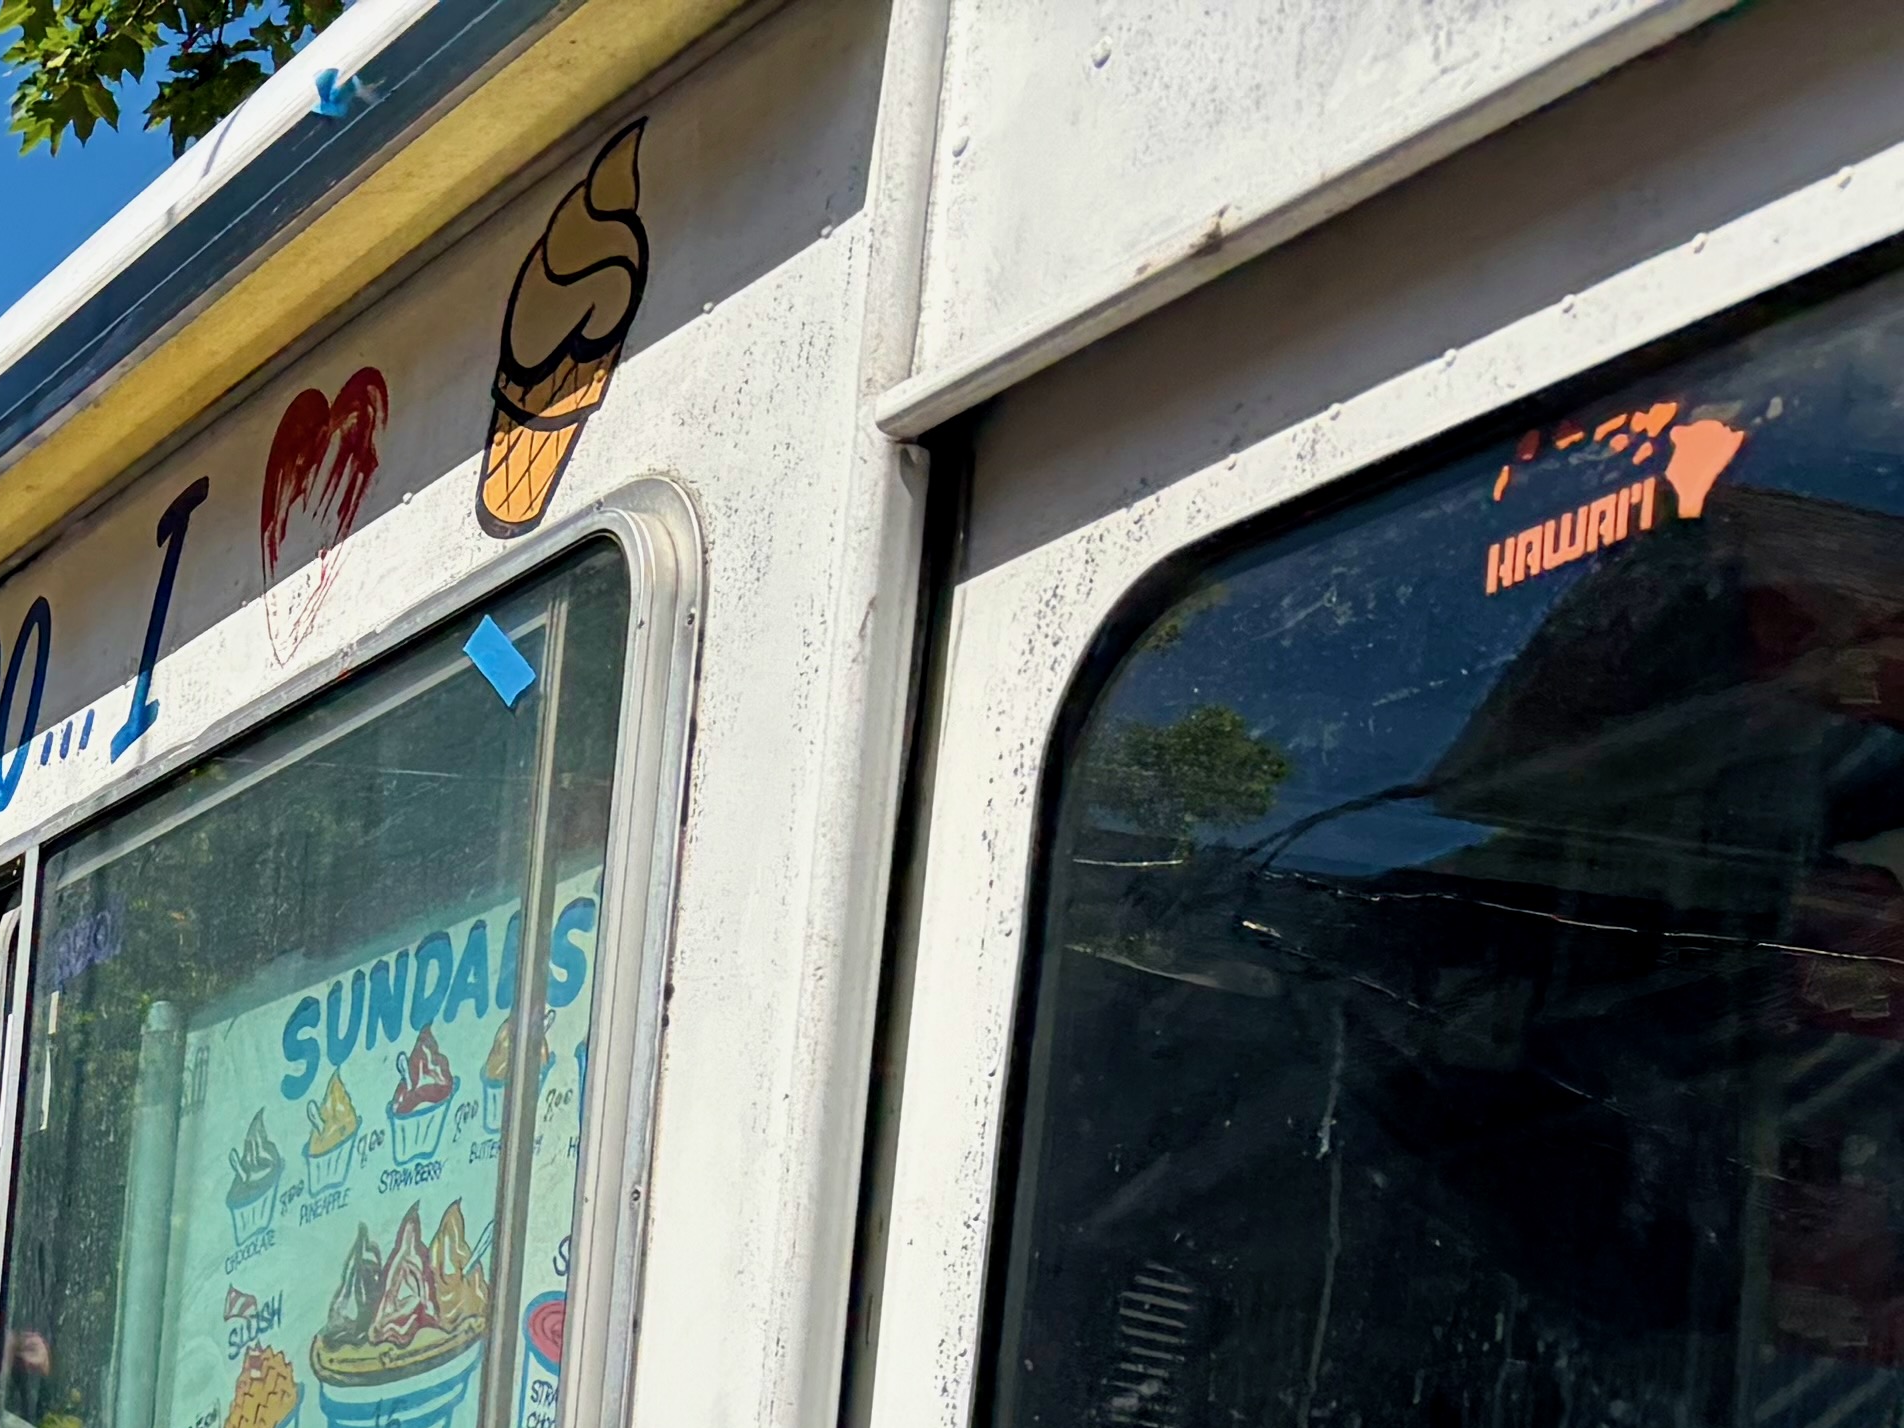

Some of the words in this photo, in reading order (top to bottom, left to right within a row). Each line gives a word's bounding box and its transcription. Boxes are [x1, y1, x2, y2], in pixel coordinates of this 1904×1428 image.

[1486, 476, 1656, 595] HAWAII
[111, 476, 209, 763] I
[299, 1187, 352, 1227] PINEAPPLE
[228, 1290, 284, 1360] SLUSH
